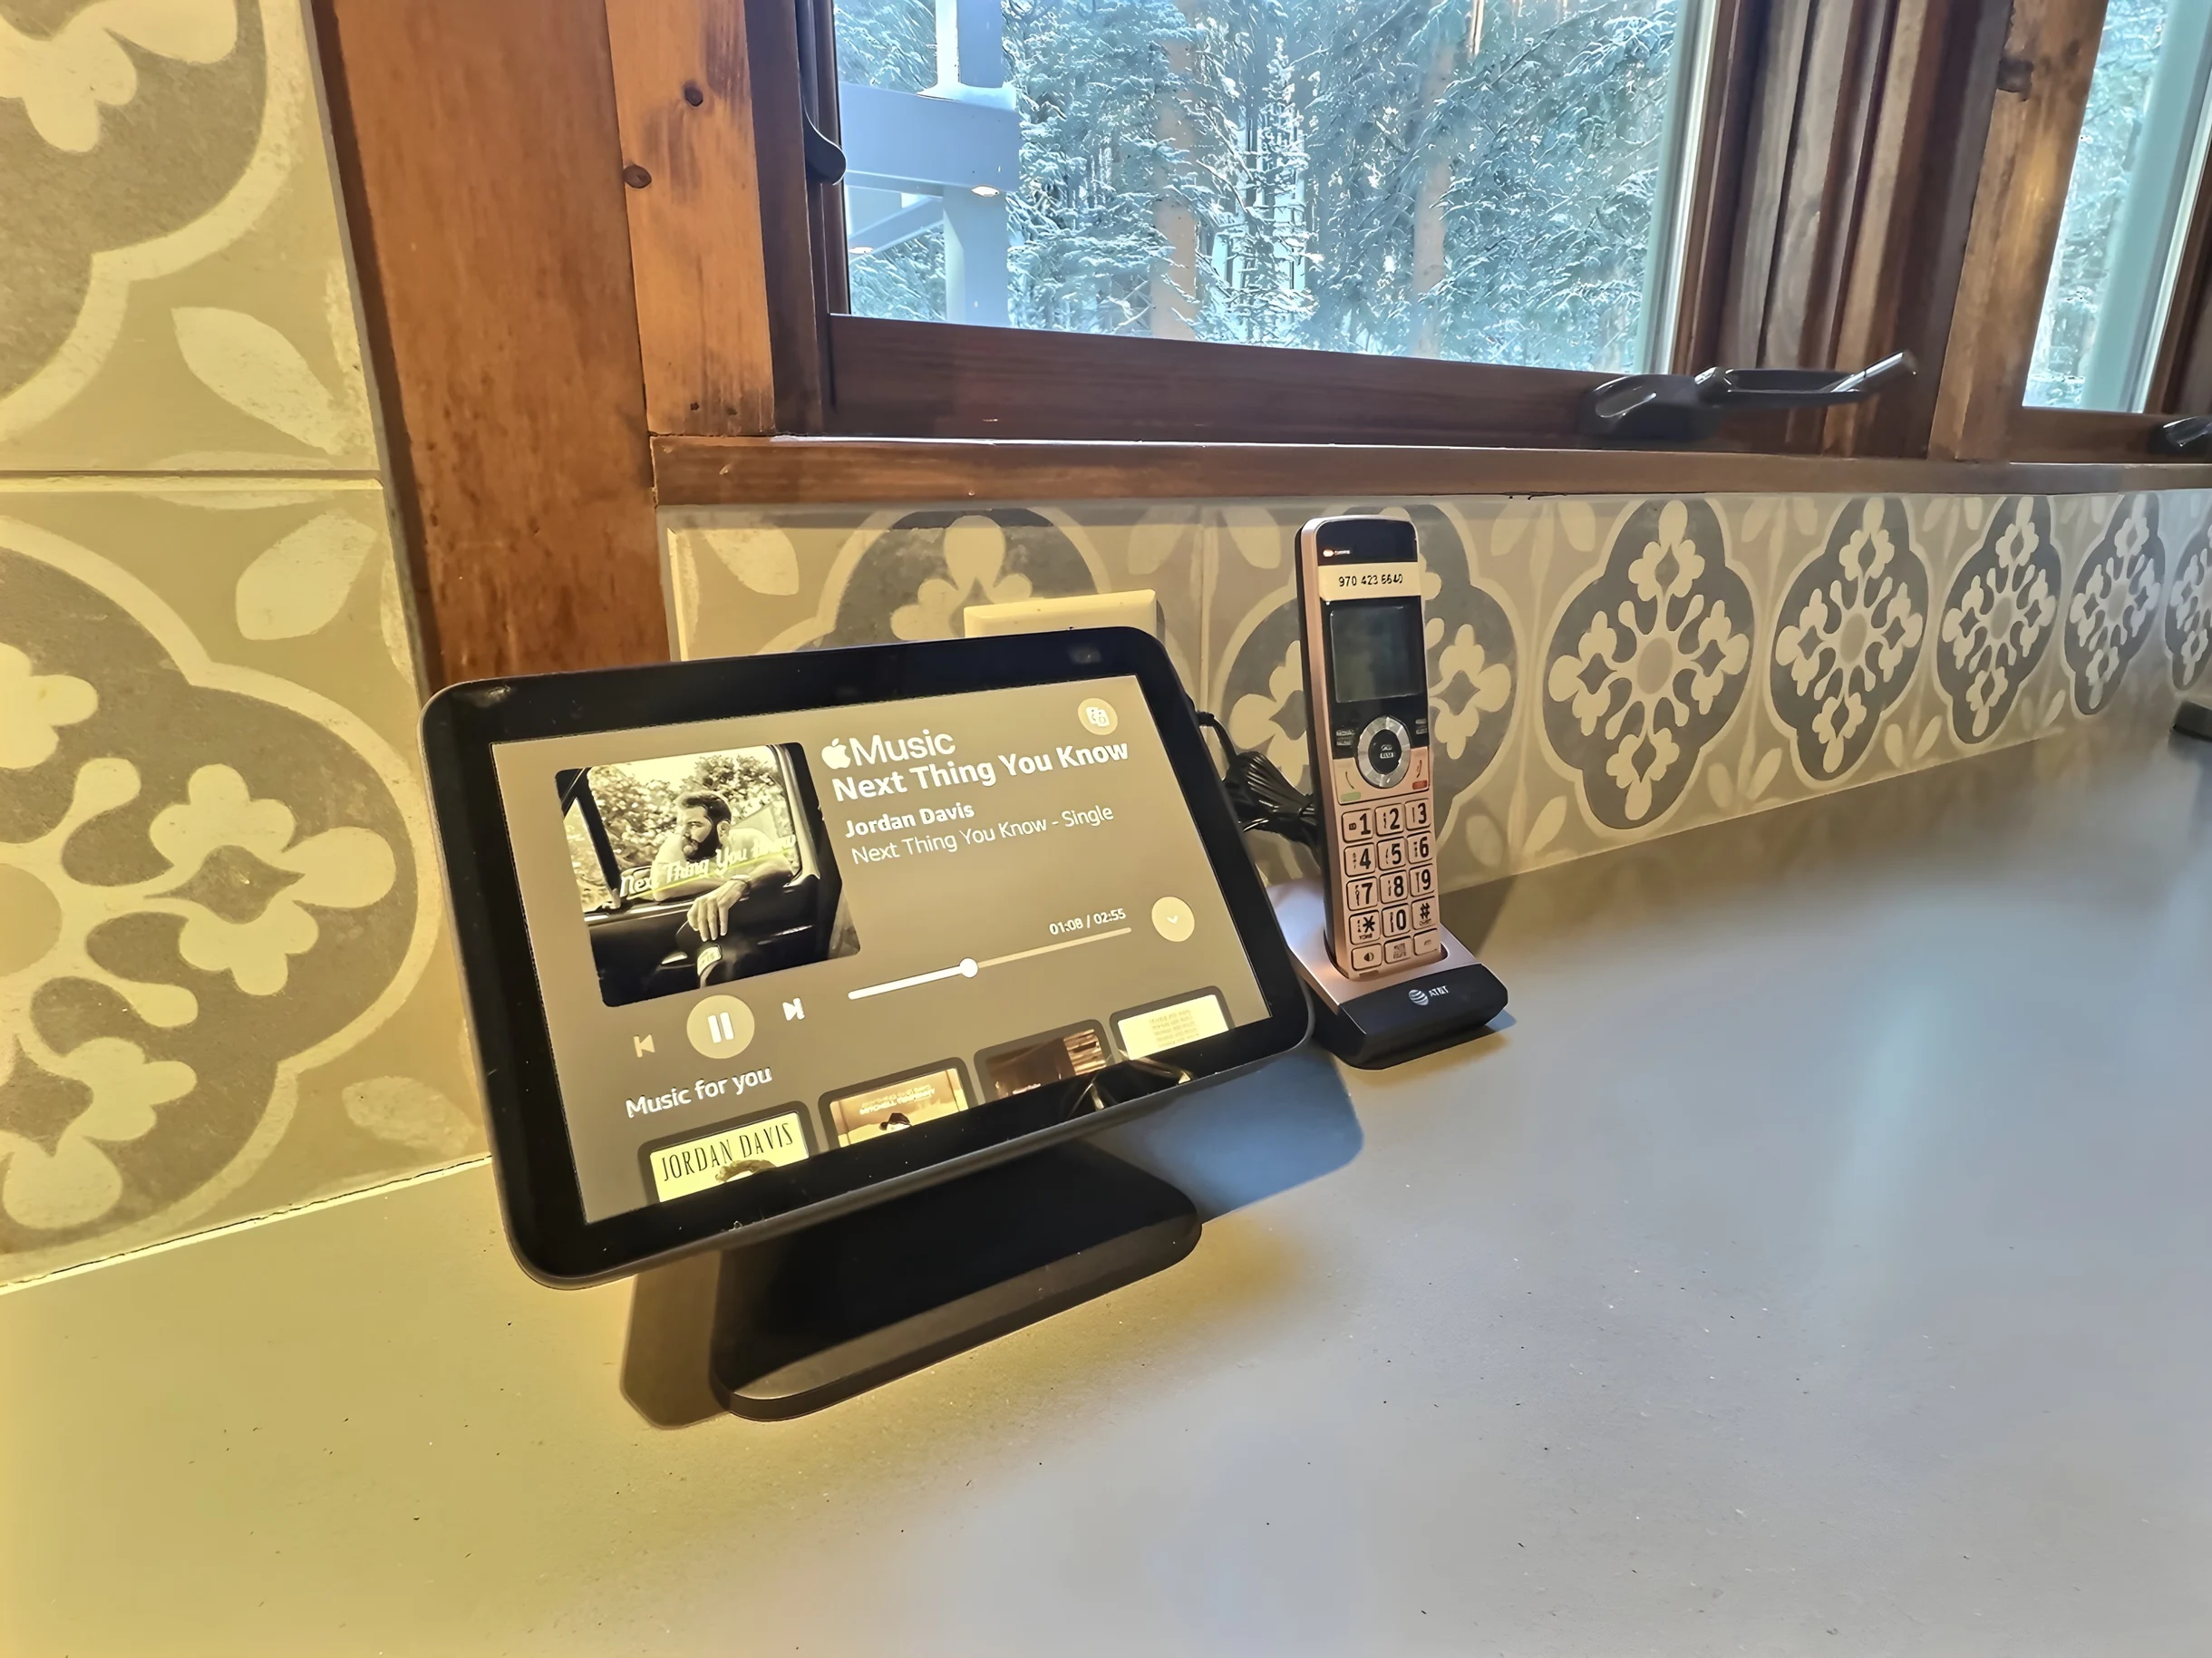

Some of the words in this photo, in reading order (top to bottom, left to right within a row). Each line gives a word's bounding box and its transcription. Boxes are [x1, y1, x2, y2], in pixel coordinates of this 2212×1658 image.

[1338, 576, 1357, 587] 970
[849, 729, 956, 766] Music
[831, 771, 907, 802] Next
[908, 761, 996, 790] Thing
[998, 753, 1053, 776] You
[1055, 742, 1129, 769] Know
[845, 813, 917, 839] Jordan
[918, 801, 975, 825] Davis
[851, 842, 900, 865] Next
[900, 835, 958, 853] Thing
[959, 828, 996, 845] You
[998, 819, 1047, 838] Know
[1061, 805, 1114, 828] Single
[1359, 812, 1371, 835] 1
[1389, 808, 1400, 829] 2
[1417, 802, 1427, 824] 3
[664, 858, 710, 882] Thing
[715, 847, 749, 876] You
[1359, 848, 1372, 869] 4
[1391, 843, 1402, 865] 5
[1419, 836, 1429, 858] 6
[1362, 882, 1373, 905] 7
[1393, 875, 1404, 897] 8
[1421, 868, 1431, 890] 9
[1049, 917, 1083, 936] 01:08
[1093, 907, 1127, 925] 02:55
[1396, 908, 1407, 930] 0
[626, 1095, 692, 1119] Music
[694, 1079, 728, 1100] for
[731, 1067, 772, 1095] you
[661, 1139, 733, 1182] JORDAN
[738, 1122, 794, 1159] DAVIS
